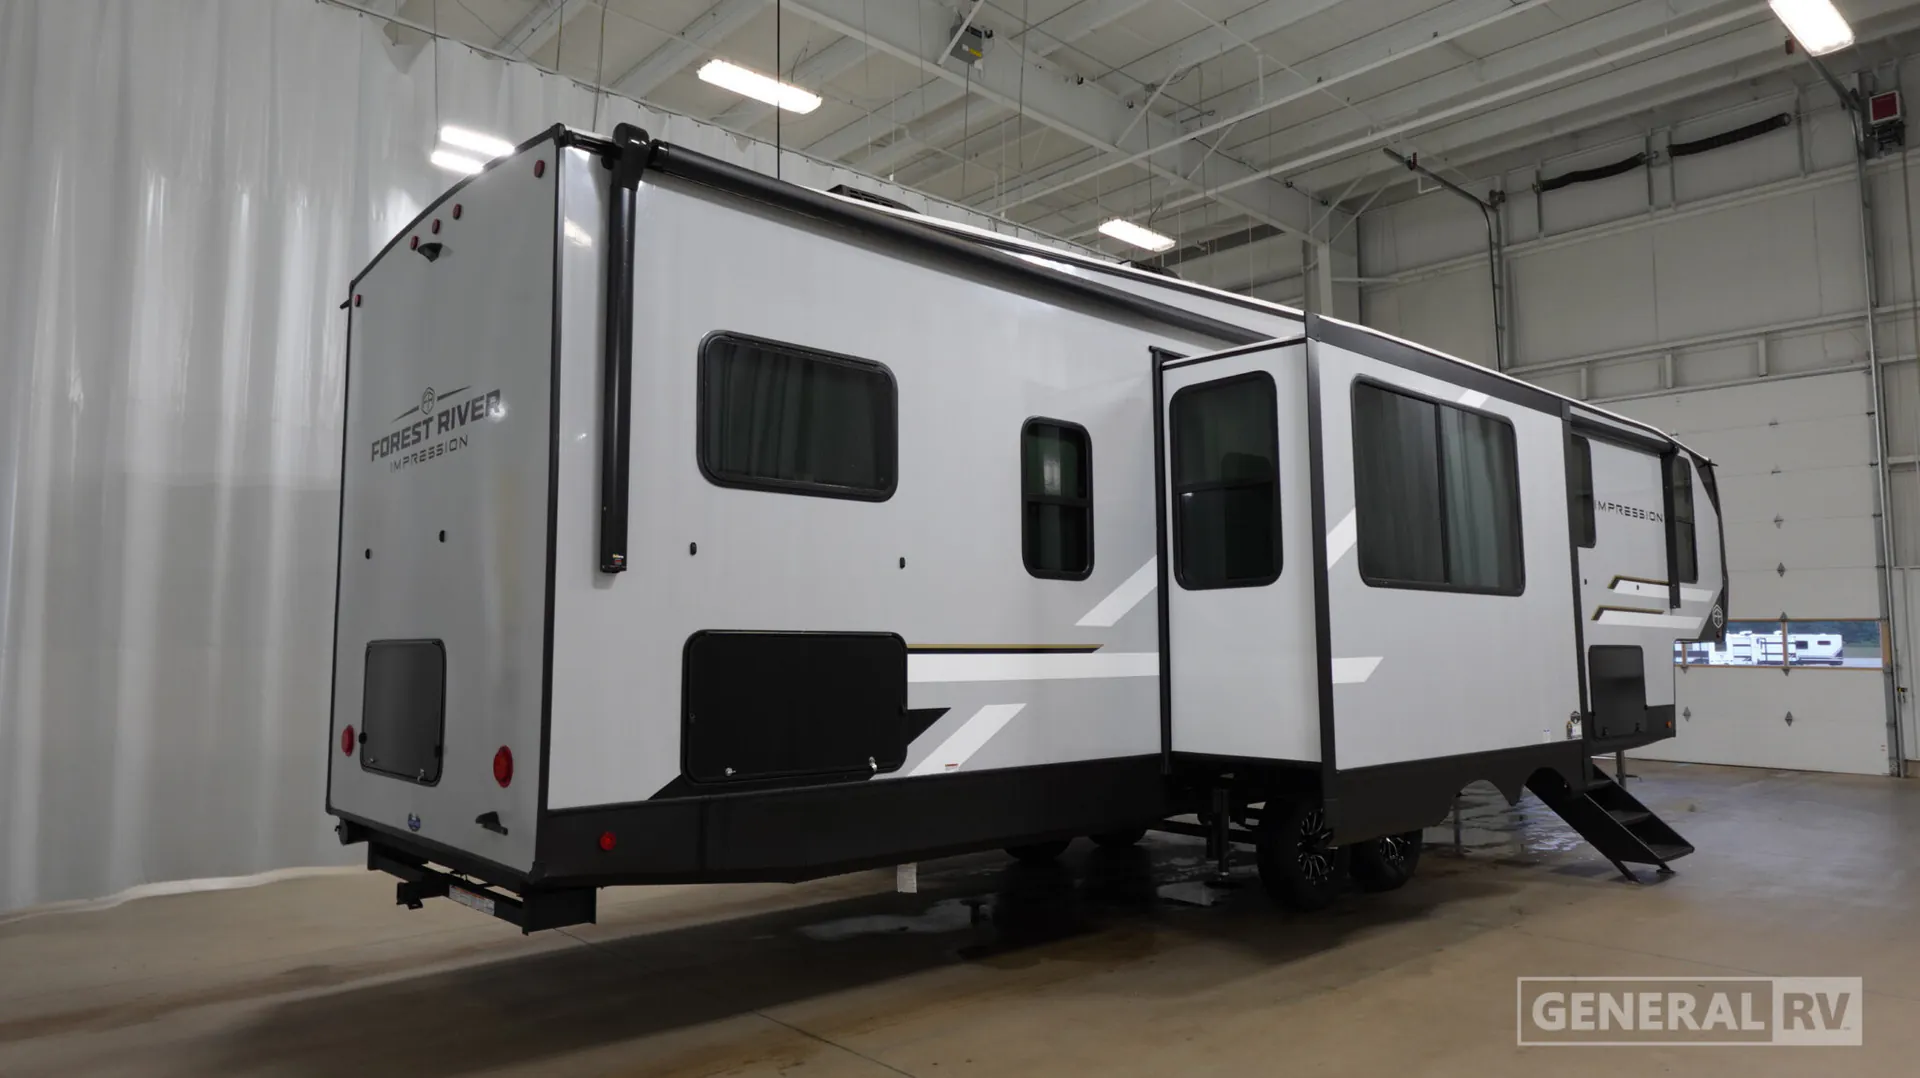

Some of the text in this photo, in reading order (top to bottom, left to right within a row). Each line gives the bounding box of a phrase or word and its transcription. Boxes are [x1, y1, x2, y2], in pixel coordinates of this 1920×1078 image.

[371, 389, 502, 462] FOREST RIVER
[390, 434, 468, 473] IMPRESSION
